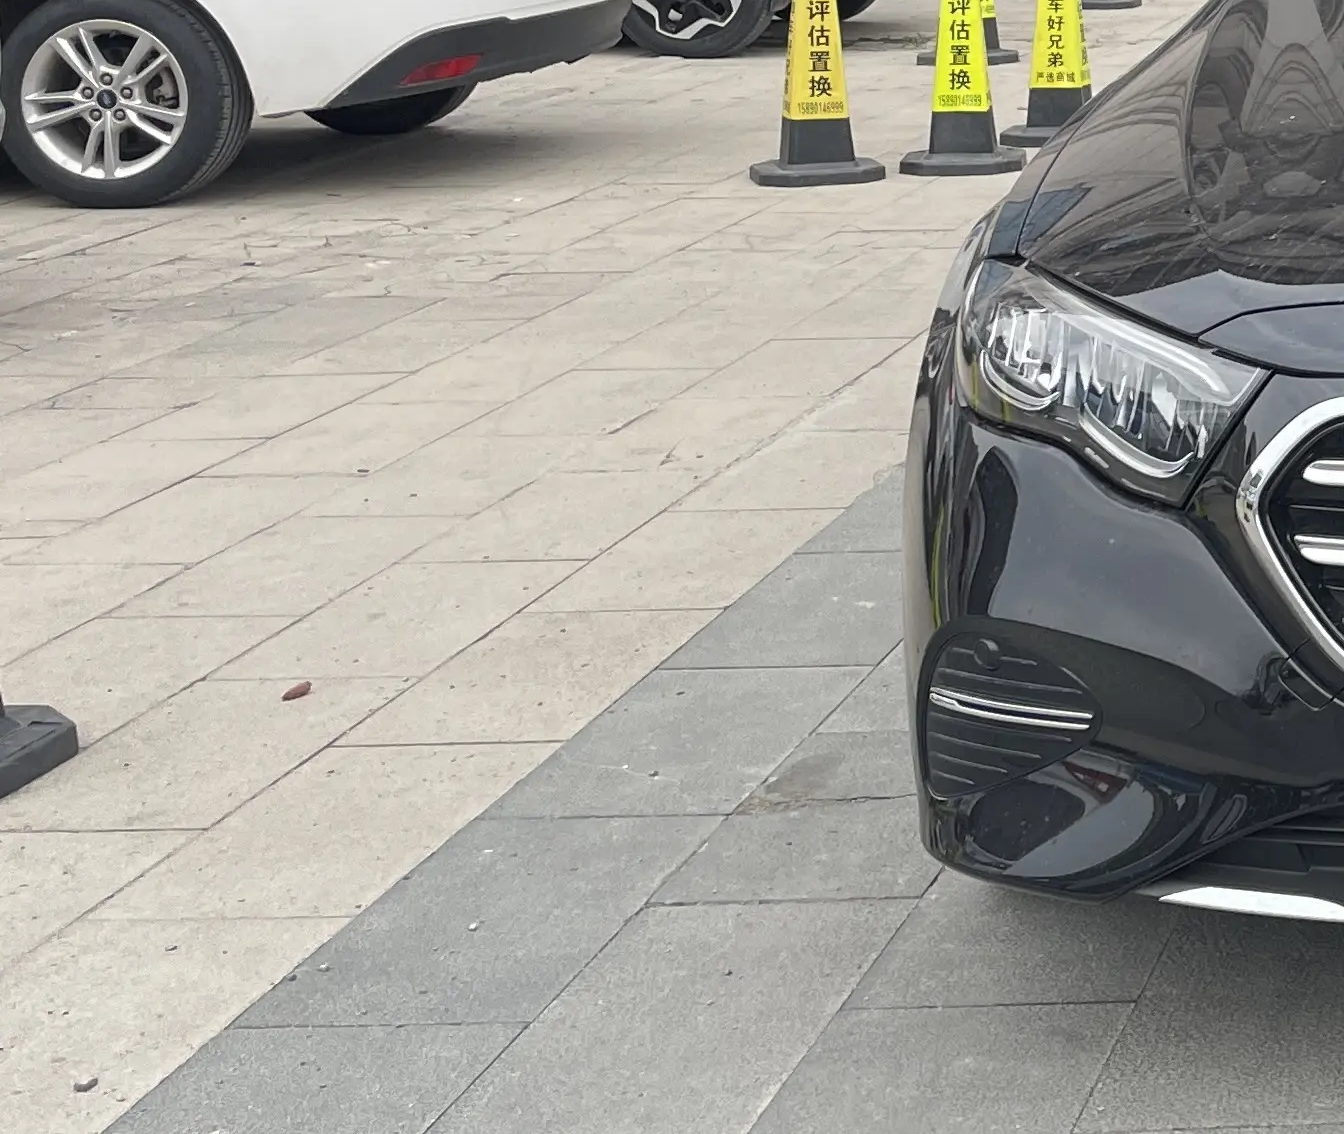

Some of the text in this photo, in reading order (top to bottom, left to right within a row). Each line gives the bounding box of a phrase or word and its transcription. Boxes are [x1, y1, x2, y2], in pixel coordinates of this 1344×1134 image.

[806, 0, 832, 98] 评估置换
[1036, 72, 1076, 83] 严选商城
